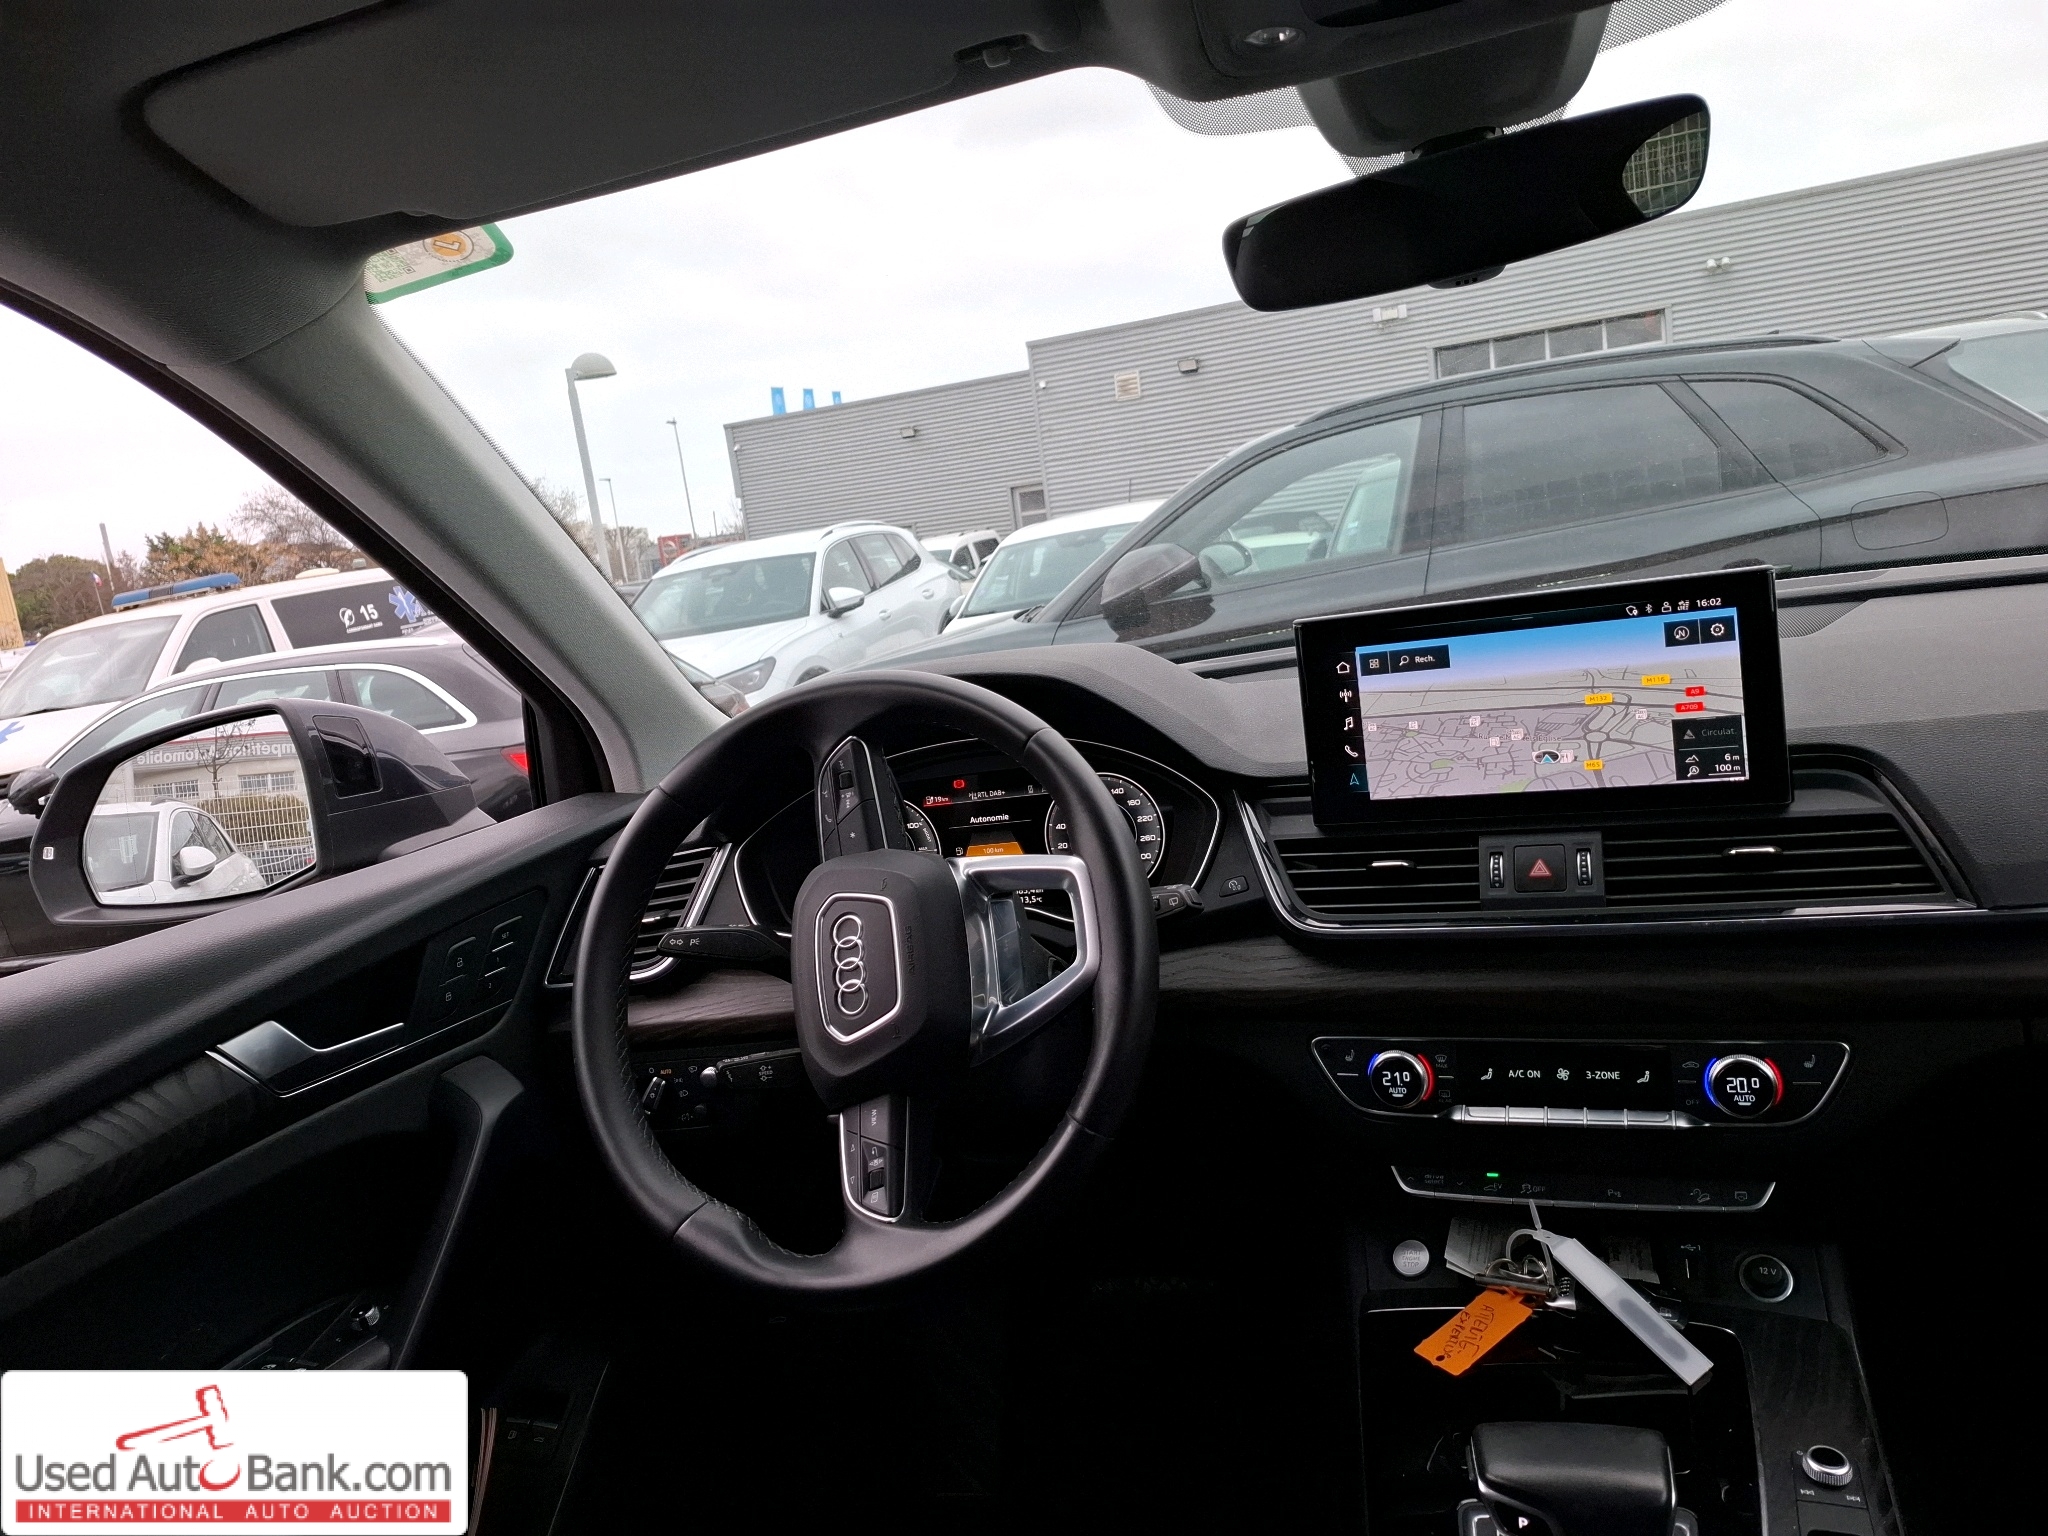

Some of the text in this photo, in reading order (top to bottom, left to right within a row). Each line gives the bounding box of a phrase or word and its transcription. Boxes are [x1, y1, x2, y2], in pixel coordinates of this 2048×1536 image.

[1696, 597, 1722, 608] 16:02
[359, 603, 379, 621] 15
[1414, 654, 1436, 664] Rech.
[1680, 703, 1699, 711] A709
[1701, 728, 1738, 737] Circulat.
[1724, 753, 1731, 761] 6
[1714, 763, 1732, 772] 100
[989, 789, 1006, 797] DAB+
[1110, 787, 1125, 795] 140
[1126, 799, 1141, 807] 180
[969, 813, 1010, 824] Autonomie
[1136, 814, 1154, 823] 220
[1139, 834, 1157, 842] 260
[1139, 852, 1153, 860] 00
[1508, 1069, 1541, 1079] A/C ON
[1585, 1070, 1621, 1080] 3-ZONE
[1733, 1094, 1756, 1102] AUTO
[1759, 1266, 1778, 1276] 12 V
[1517, 1516, 1530, 1530] P
